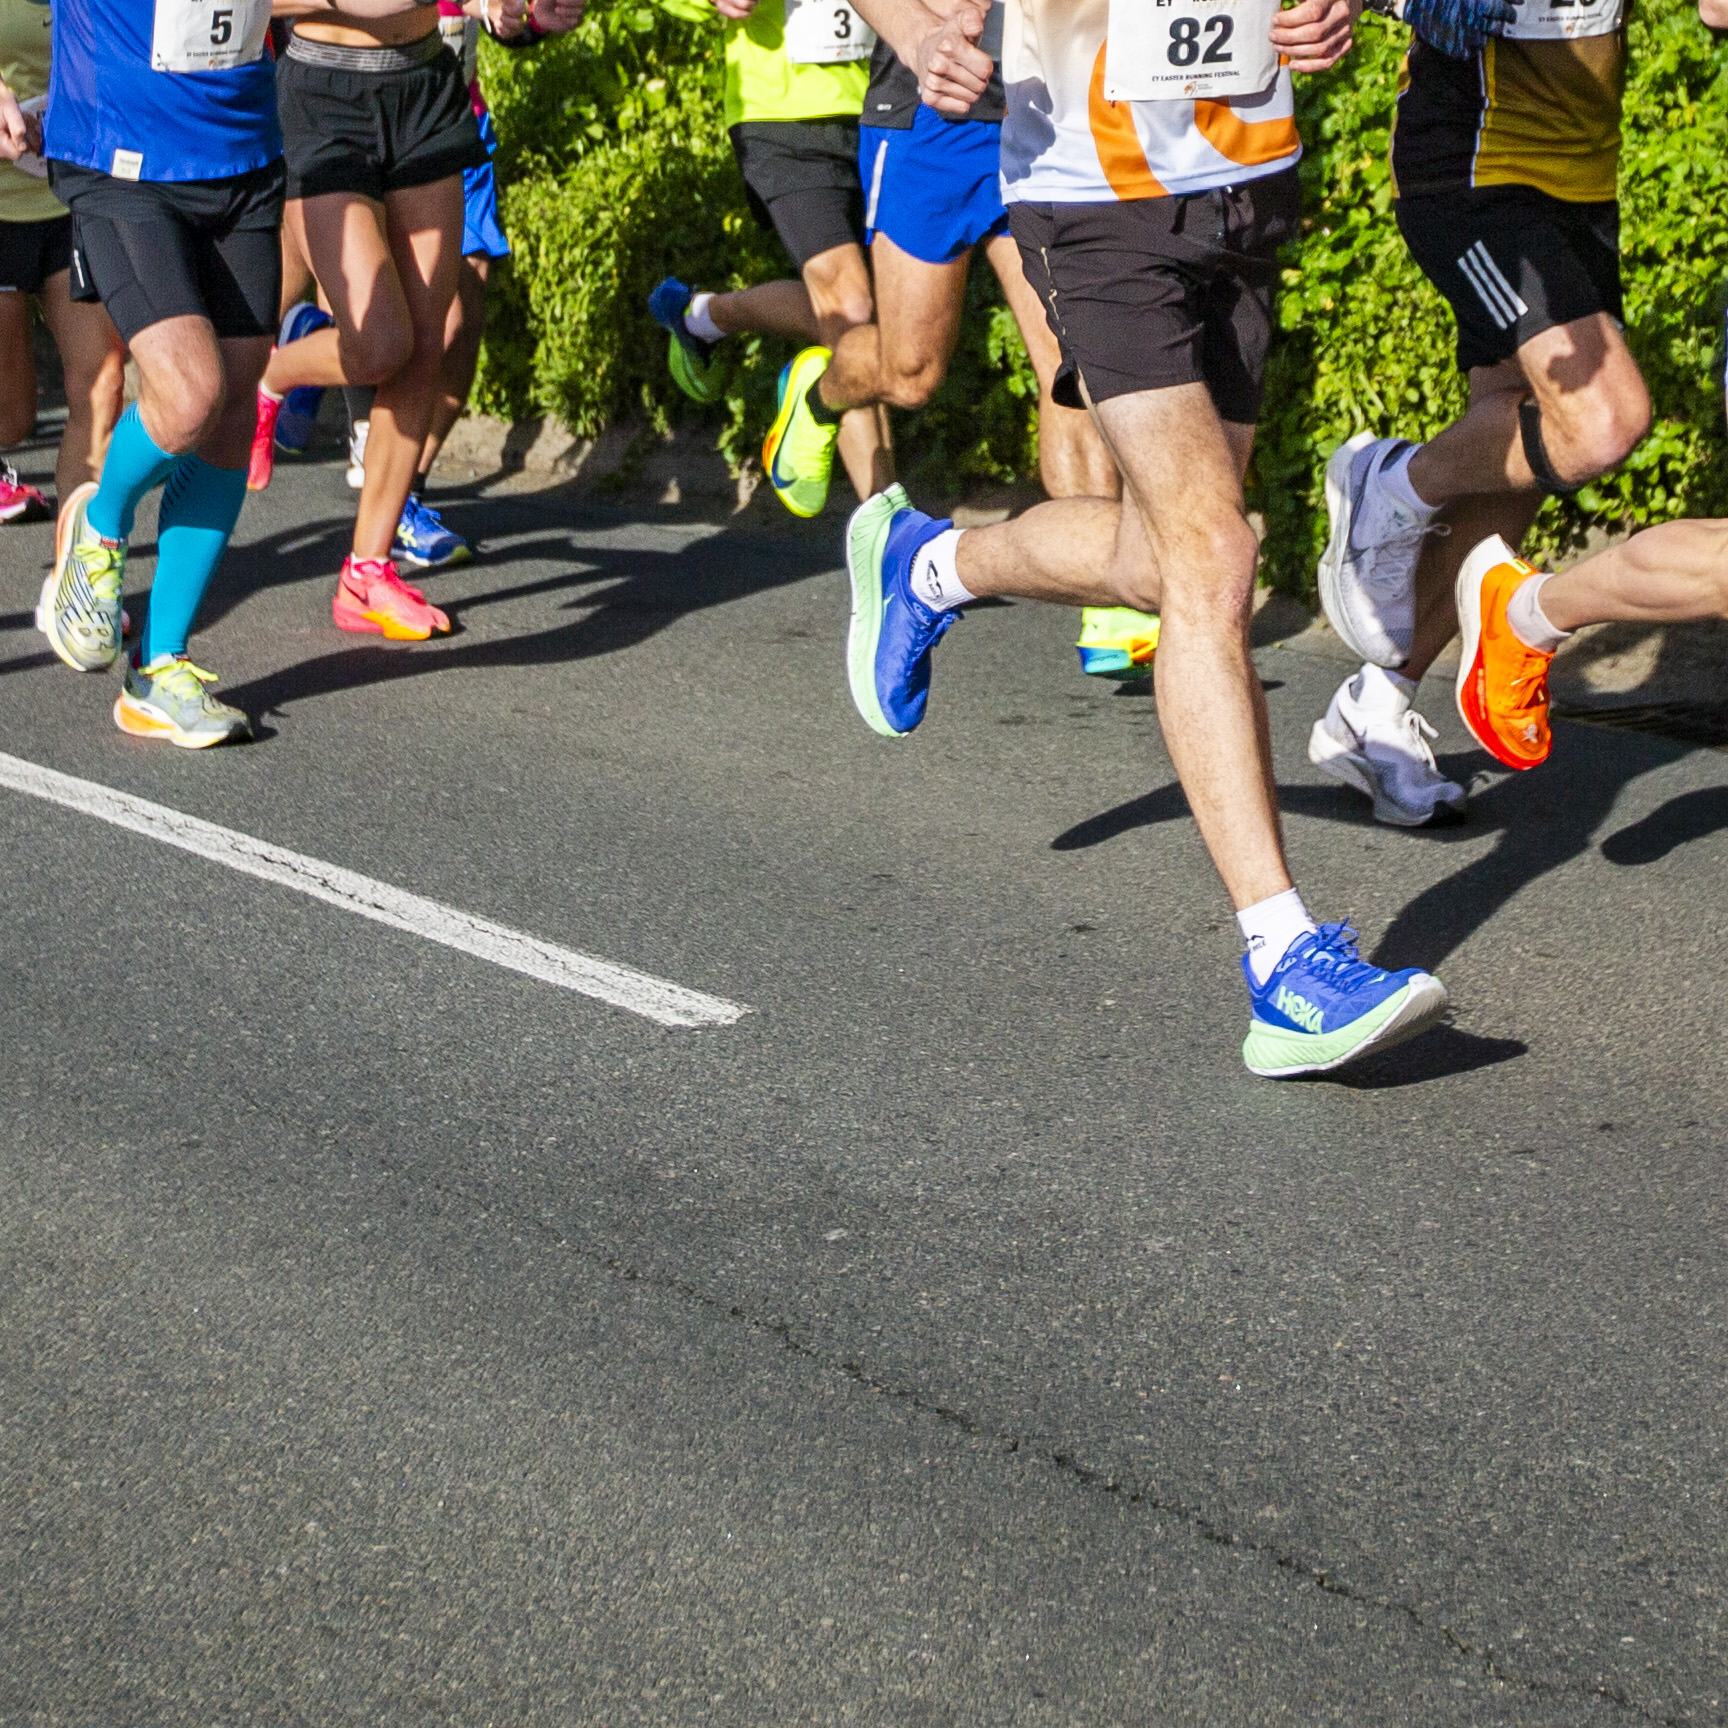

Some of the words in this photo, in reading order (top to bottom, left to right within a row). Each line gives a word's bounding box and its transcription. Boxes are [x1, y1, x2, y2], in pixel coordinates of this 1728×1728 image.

[210, 9, 233, 46] 5
[833, 8, 851, 40] 3
[1166, 13, 1235, 67] 82
[1277, 985, 1324, 1035] HOKA
